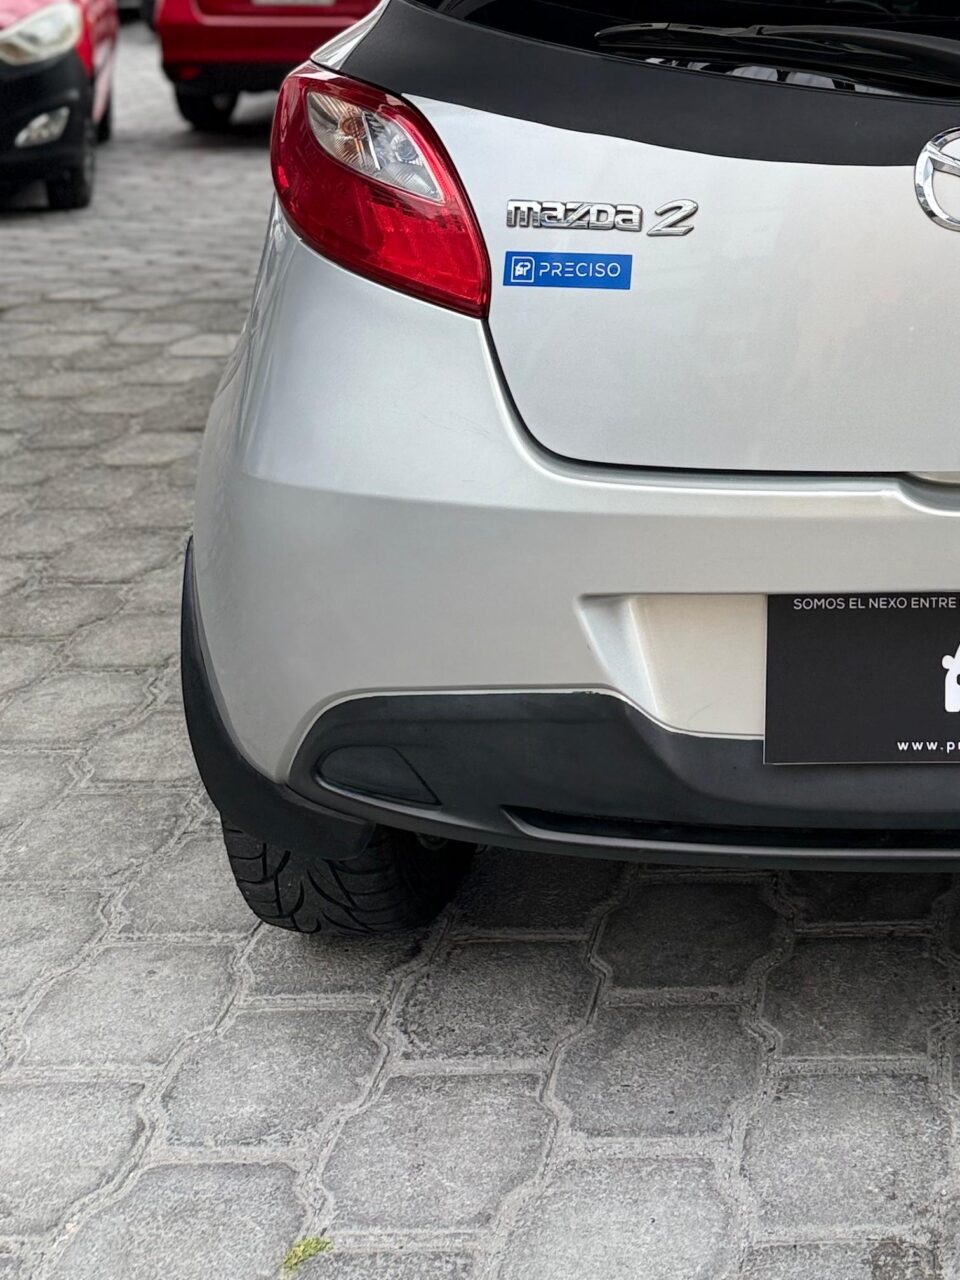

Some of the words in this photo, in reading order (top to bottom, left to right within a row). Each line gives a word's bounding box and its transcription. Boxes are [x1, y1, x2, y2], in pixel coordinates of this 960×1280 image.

[646, 198, 699, 237] 2
[538, 261, 622, 278] PRECISO
[793, 597, 846, 610] SOMOS
[849, 597, 866, 609] EL
[868, 597, 908, 609] NEXO
[910, 596, 957, 609] ENTRE
